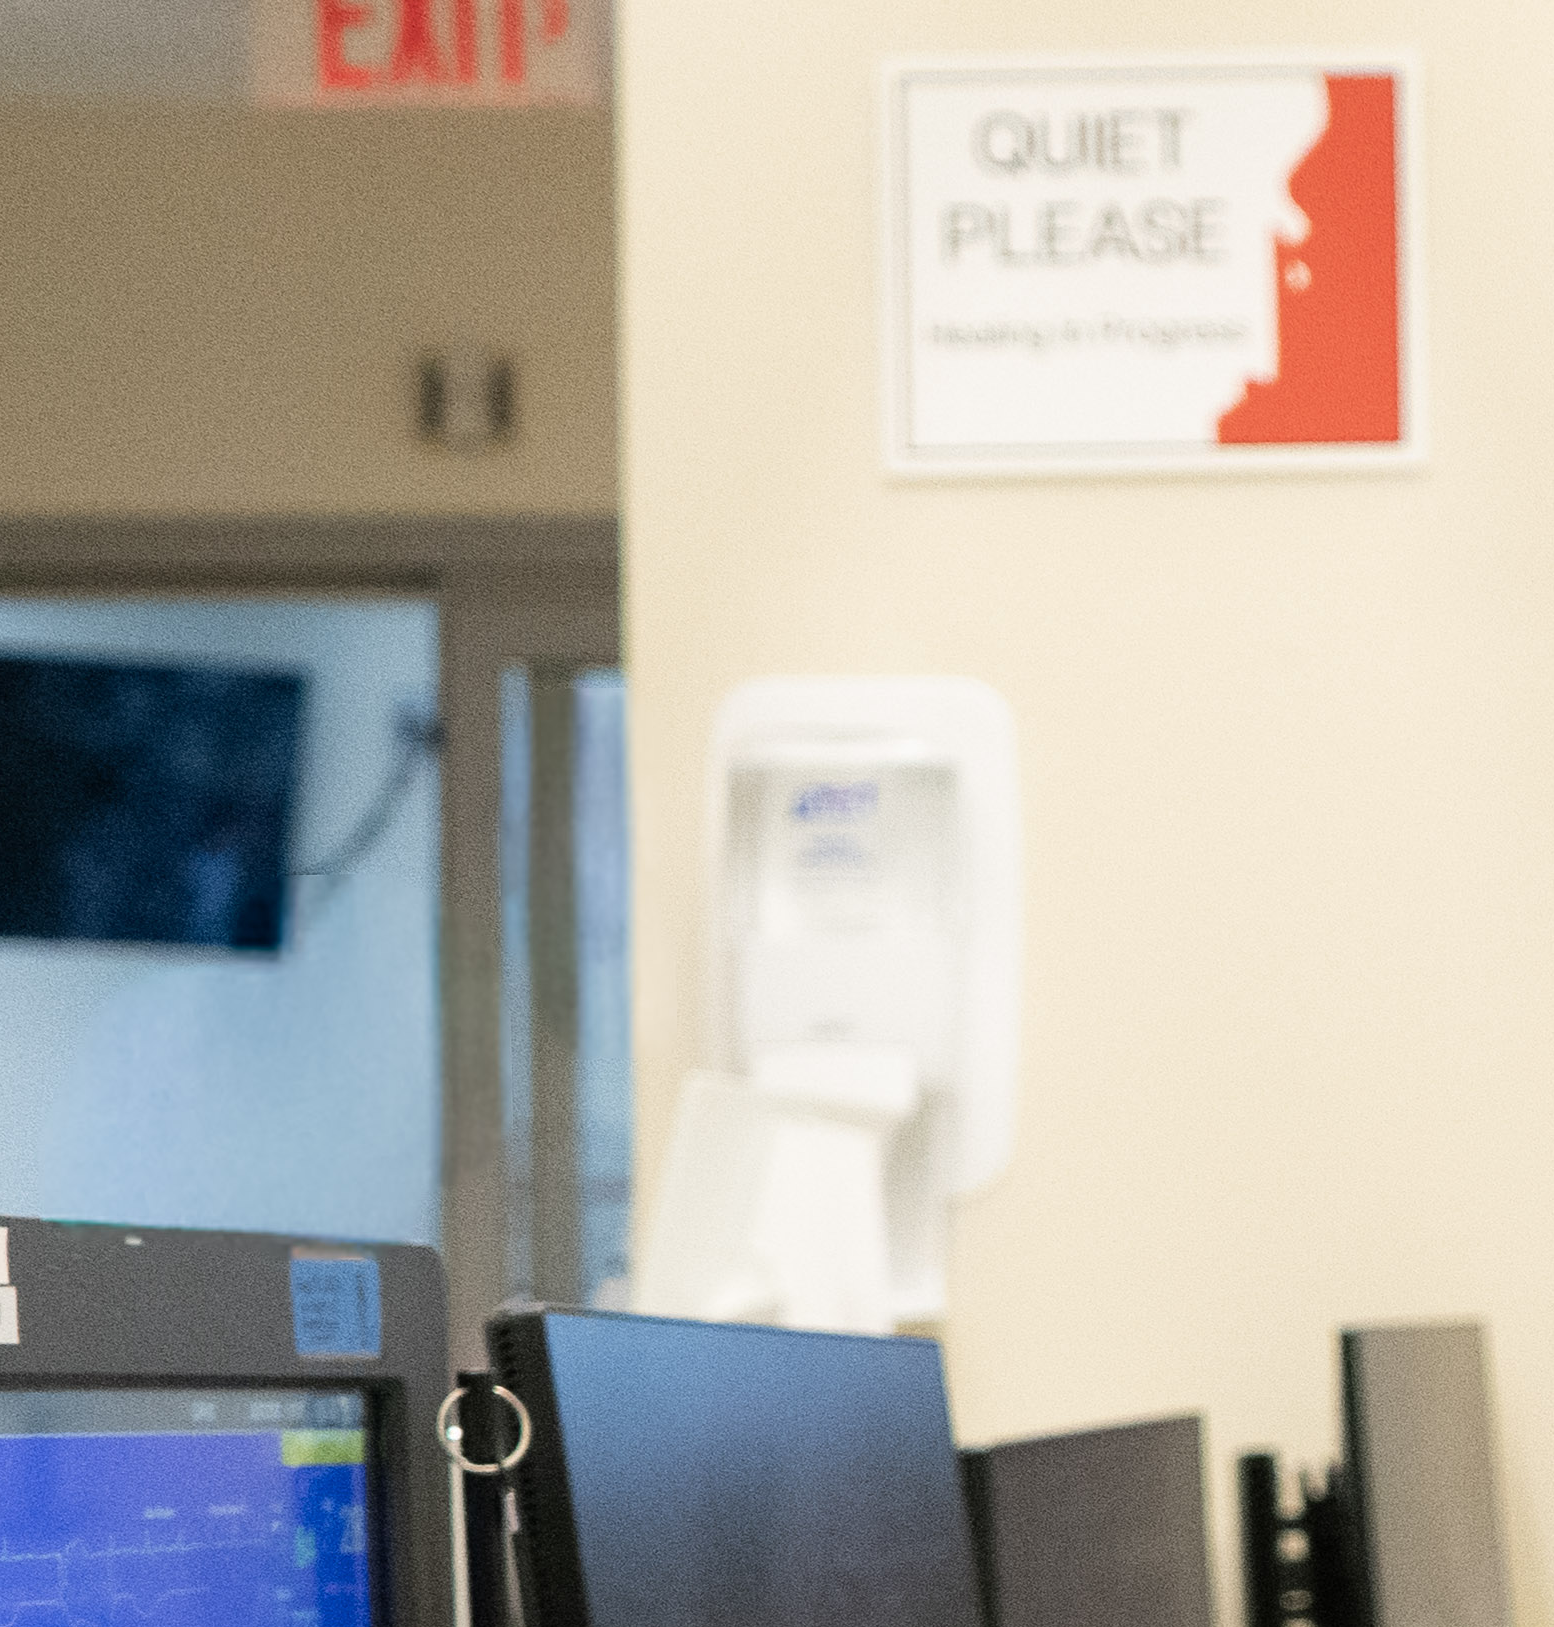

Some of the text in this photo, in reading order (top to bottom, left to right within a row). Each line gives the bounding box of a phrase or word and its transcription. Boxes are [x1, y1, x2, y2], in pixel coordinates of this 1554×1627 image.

[317, 0, 526, 88] EXIT
[969, 107, 1190, 176] QUIET
[941, 198, 1229, 267] PLEASE
